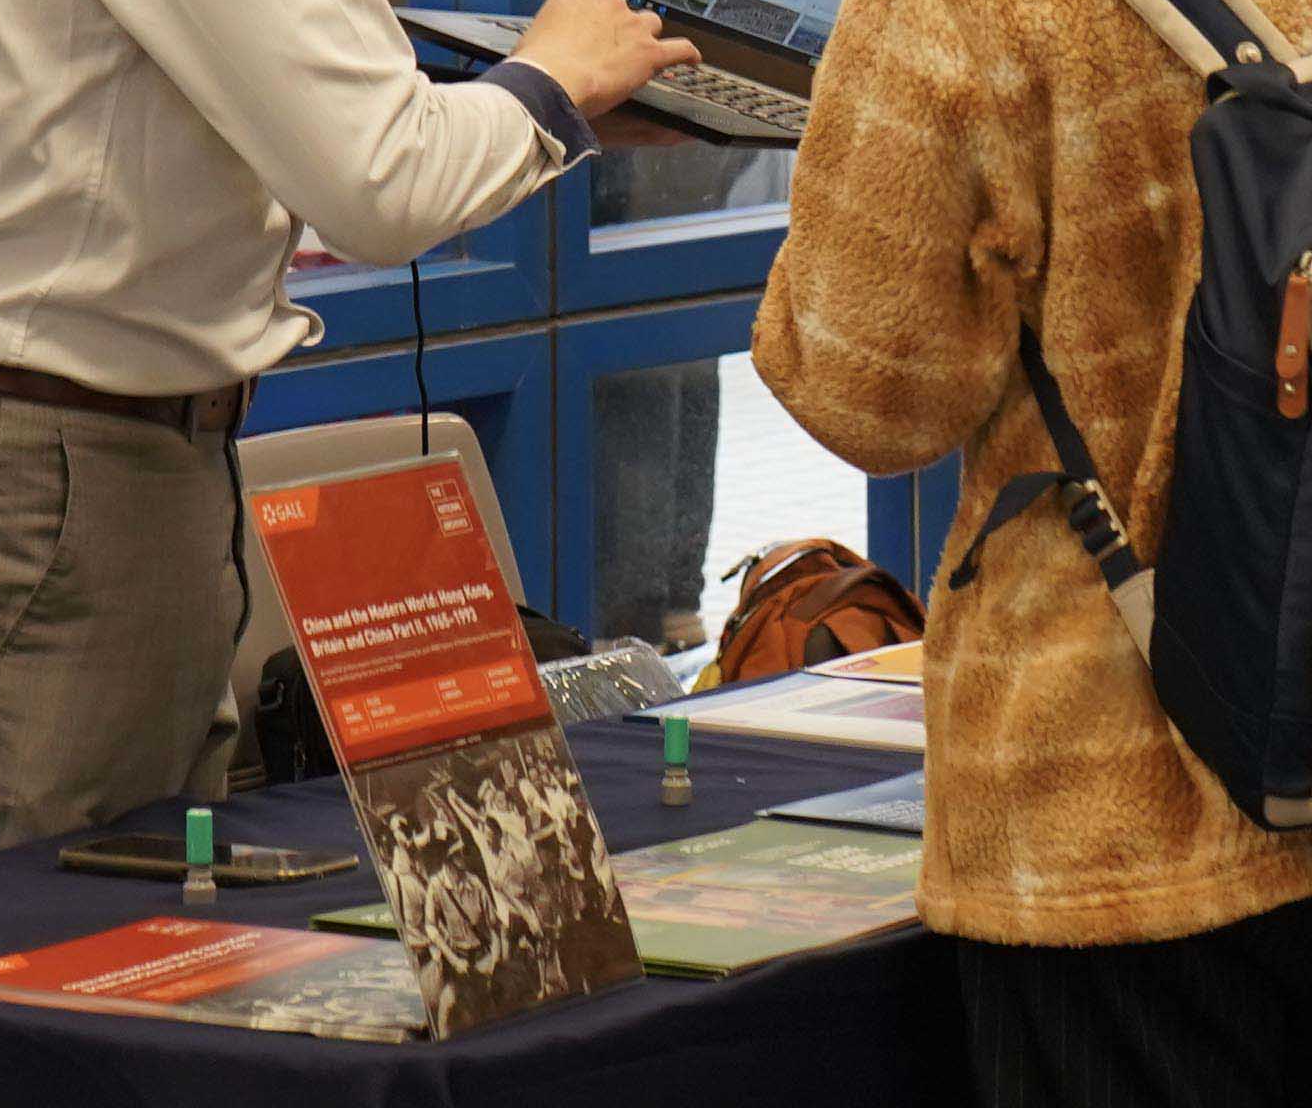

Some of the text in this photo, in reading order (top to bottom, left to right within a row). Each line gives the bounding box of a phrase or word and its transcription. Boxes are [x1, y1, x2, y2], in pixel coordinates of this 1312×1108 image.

[276, 500, 305, 521] GALE
[302, 583, 494, 635] China and the Modern World: Hong Kong,
[310, 636, 346, 657] Britain
[346, 631, 365, 651] and
[364, 626, 394, 646] China
[392, 619, 414, 639] Part
